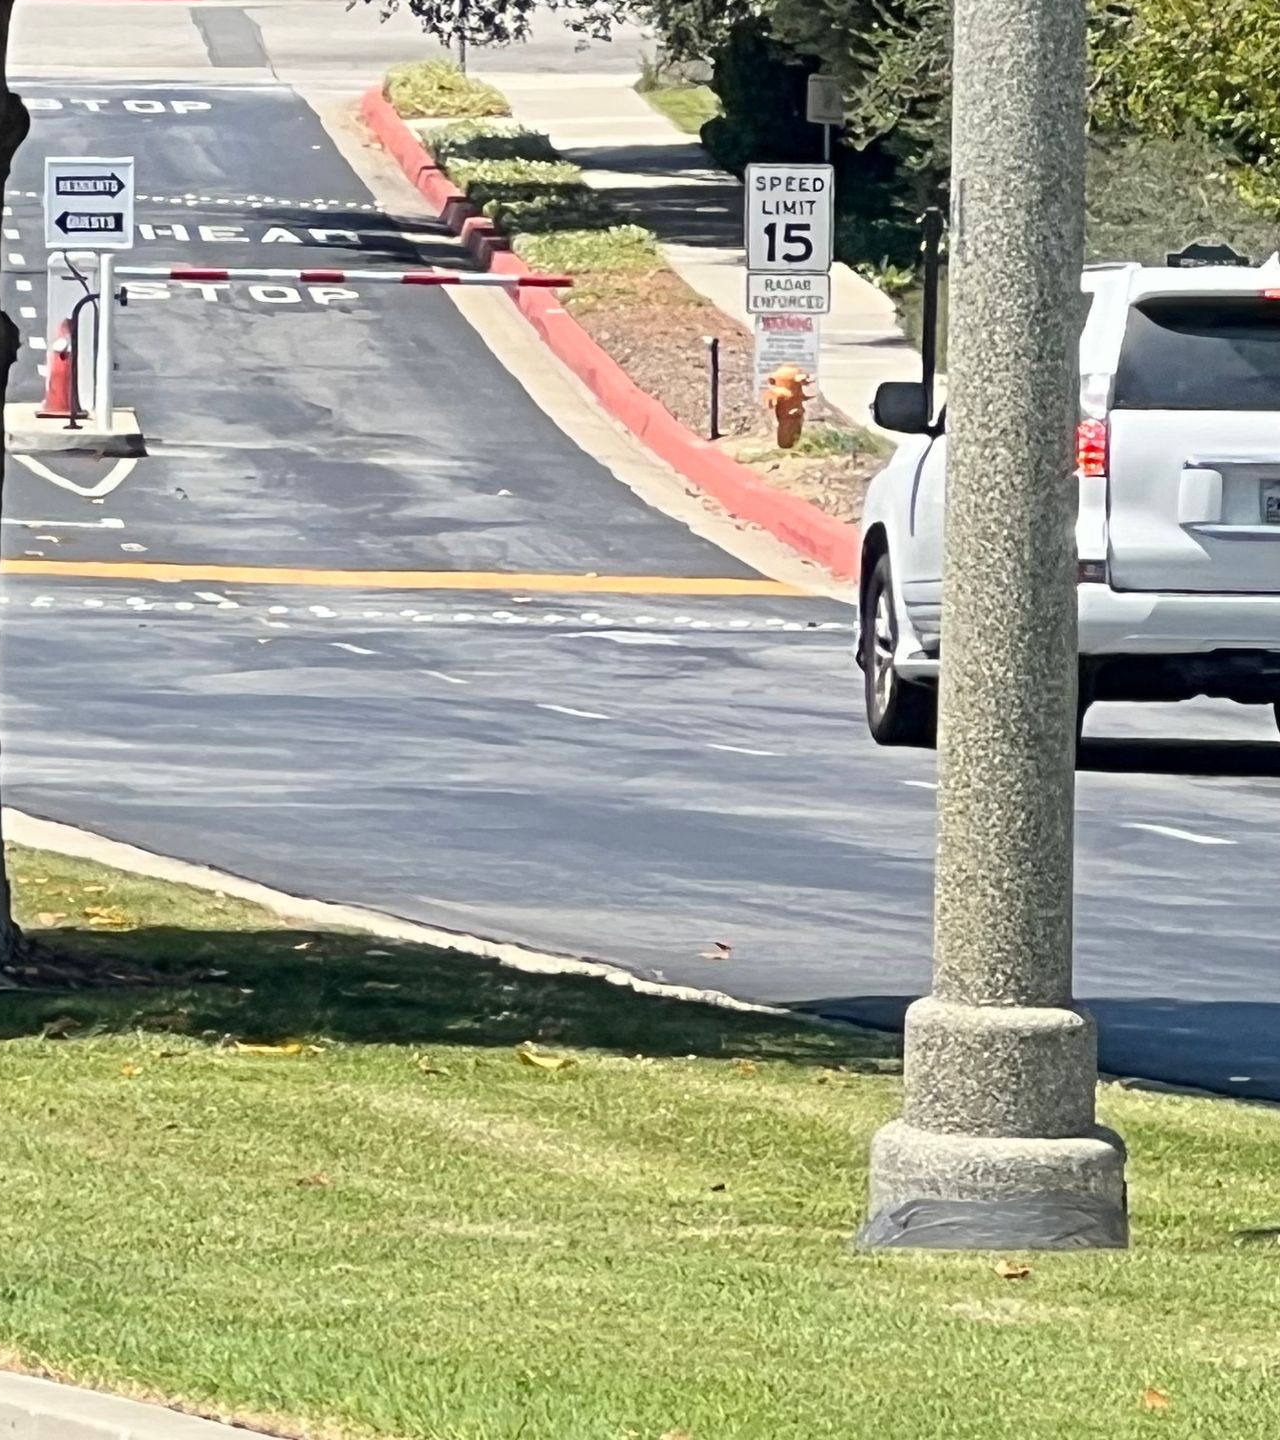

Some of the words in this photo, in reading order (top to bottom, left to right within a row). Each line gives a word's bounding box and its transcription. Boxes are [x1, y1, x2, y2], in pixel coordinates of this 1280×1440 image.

[755, 175, 825, 193] SPEED
[761, 200, 817, 216] LIMIT
[138, 223, 361, 245] HEAD
[763, 222, 814, 263] 15
[121, 281, 360, 305] STOP
